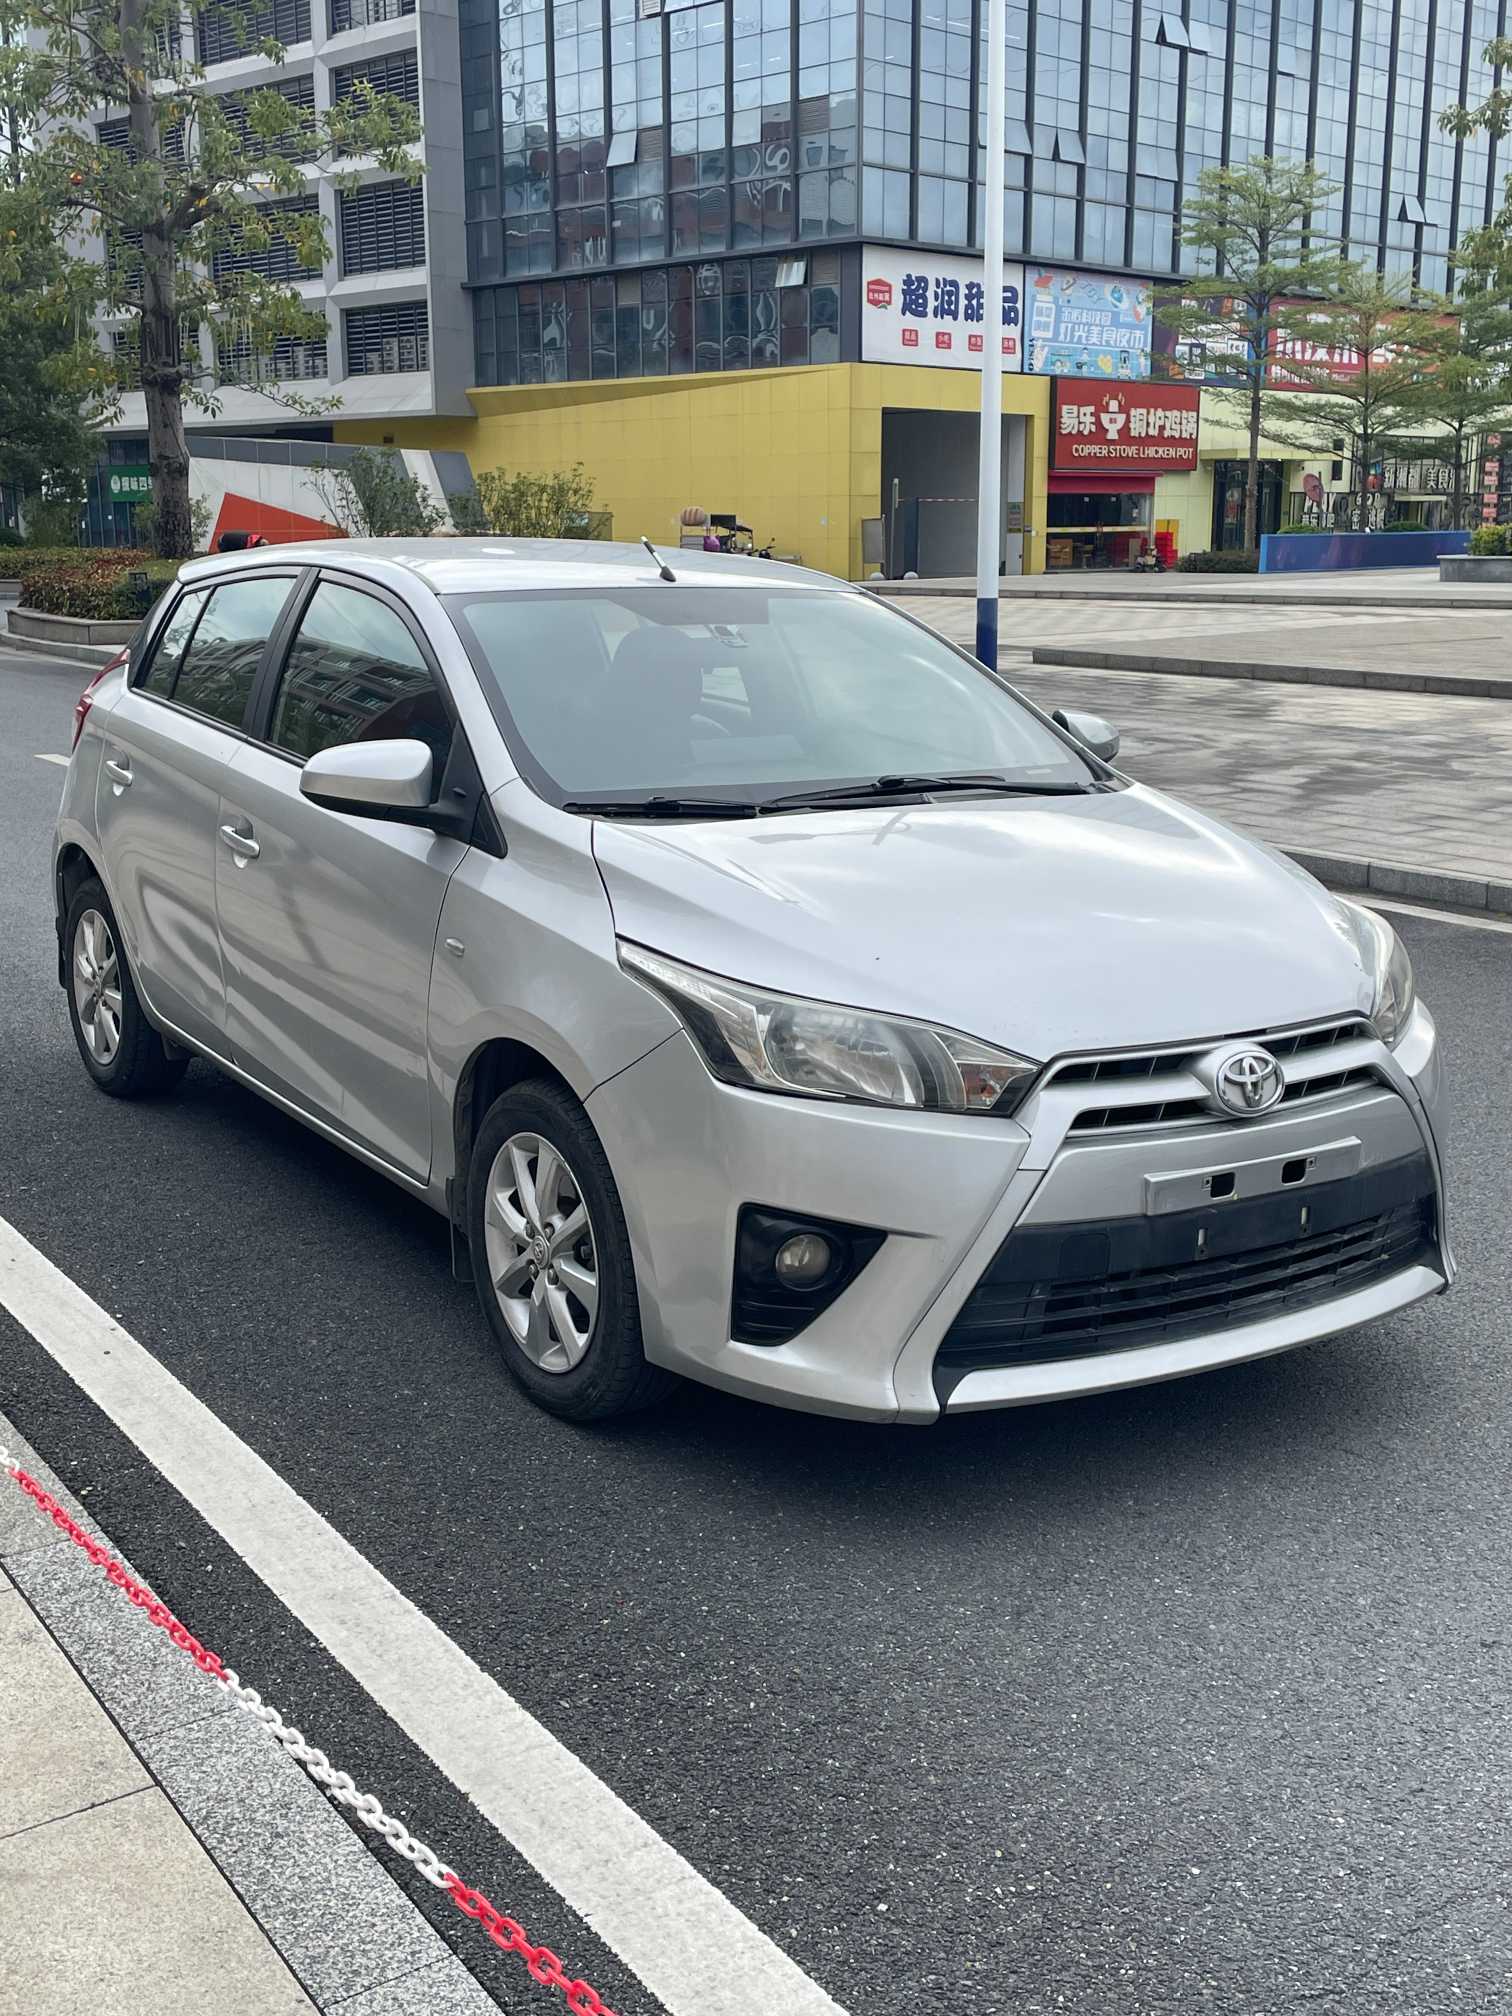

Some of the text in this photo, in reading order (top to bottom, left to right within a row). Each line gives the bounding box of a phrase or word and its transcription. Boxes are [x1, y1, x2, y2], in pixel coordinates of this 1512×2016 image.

[901, 273, 1019, 327] 超润甜品
[1058, 322, 1145, 348] 灯光美食夜市
[1060, 404, 1198, 439] 易乐 铜炉鸡锅
[1072, 443, 1109, 458] COPPER
[1109, 445, 1138, 459] STOVE
[1177, 447, 1194, 460] POT
[1351, 507, 1386, 530] 密逃脱
